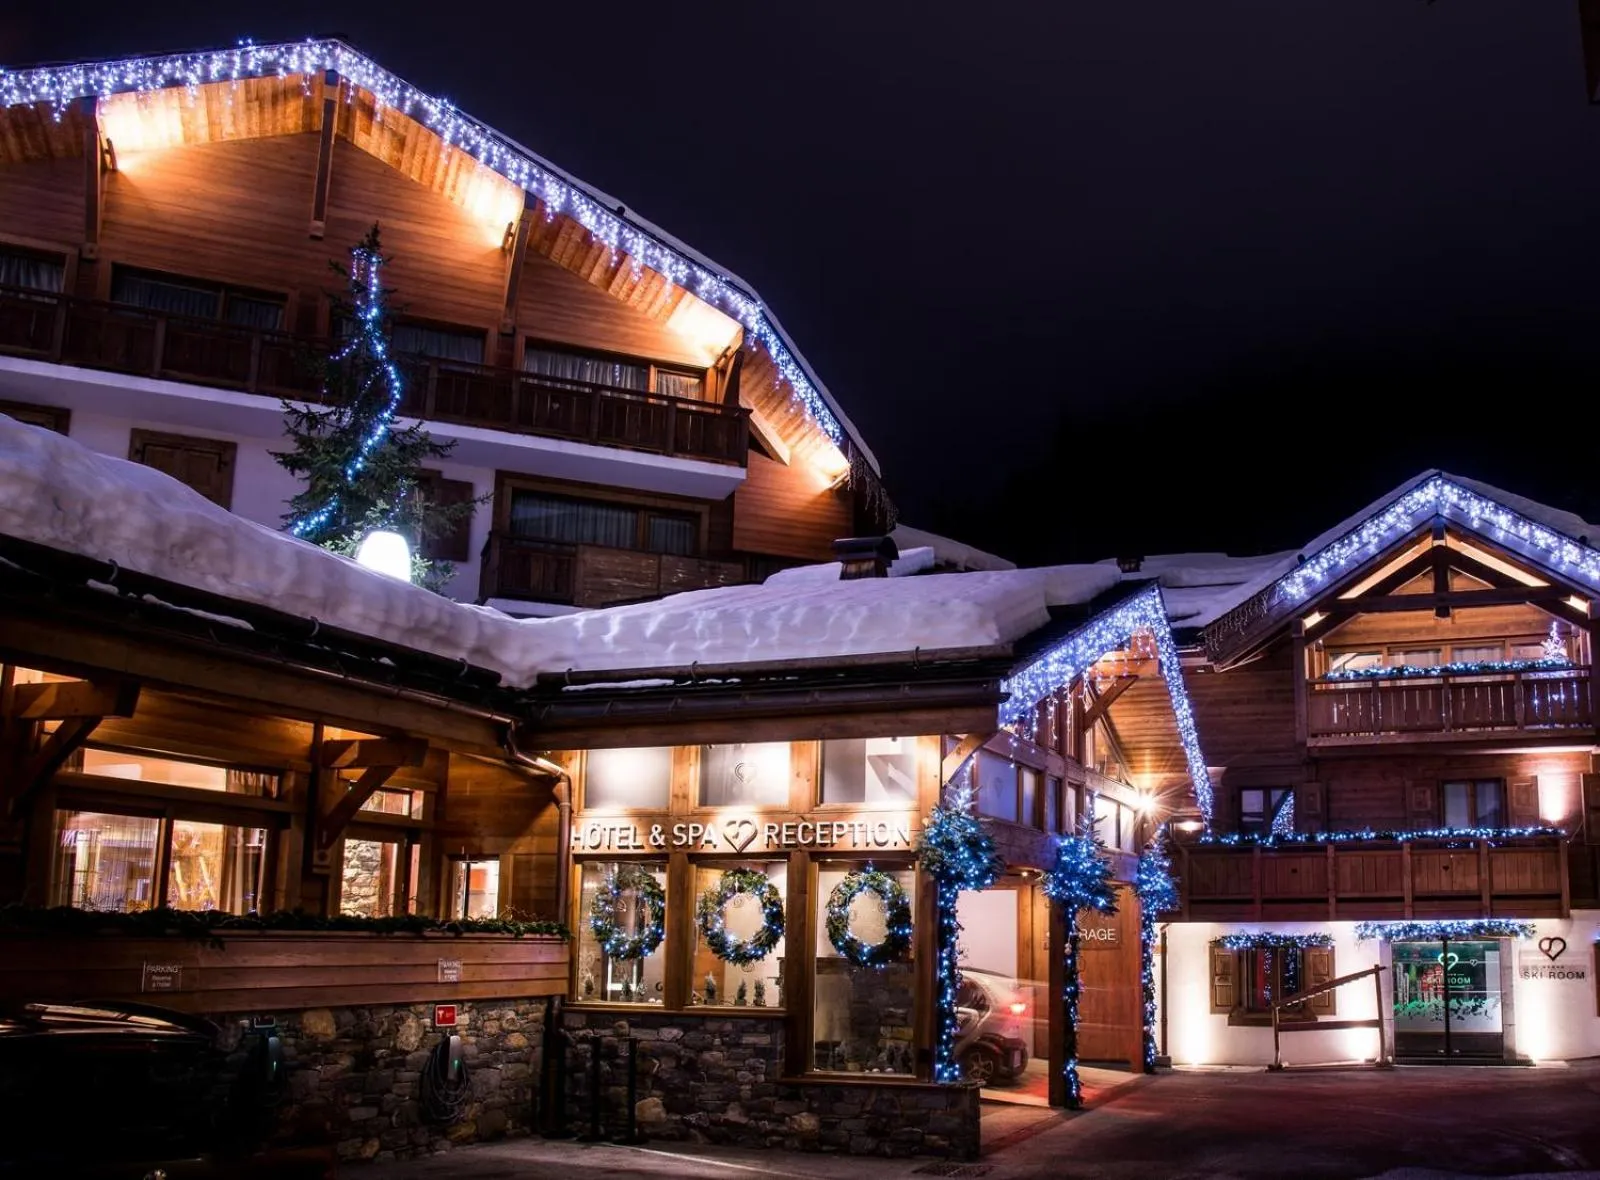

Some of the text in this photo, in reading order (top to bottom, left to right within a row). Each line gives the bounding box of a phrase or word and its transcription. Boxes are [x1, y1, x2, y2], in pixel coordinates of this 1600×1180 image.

[648, 824, 665, 847] &
[672, 823, 718, 847] SPA
[764, 821, 911, 846] RECEPTION
[1079, 928, 1117, 941] RAGE
[1447, 977, 1471, 985] OOM
[1523, 971, 1585, 980] SKI ROOM
